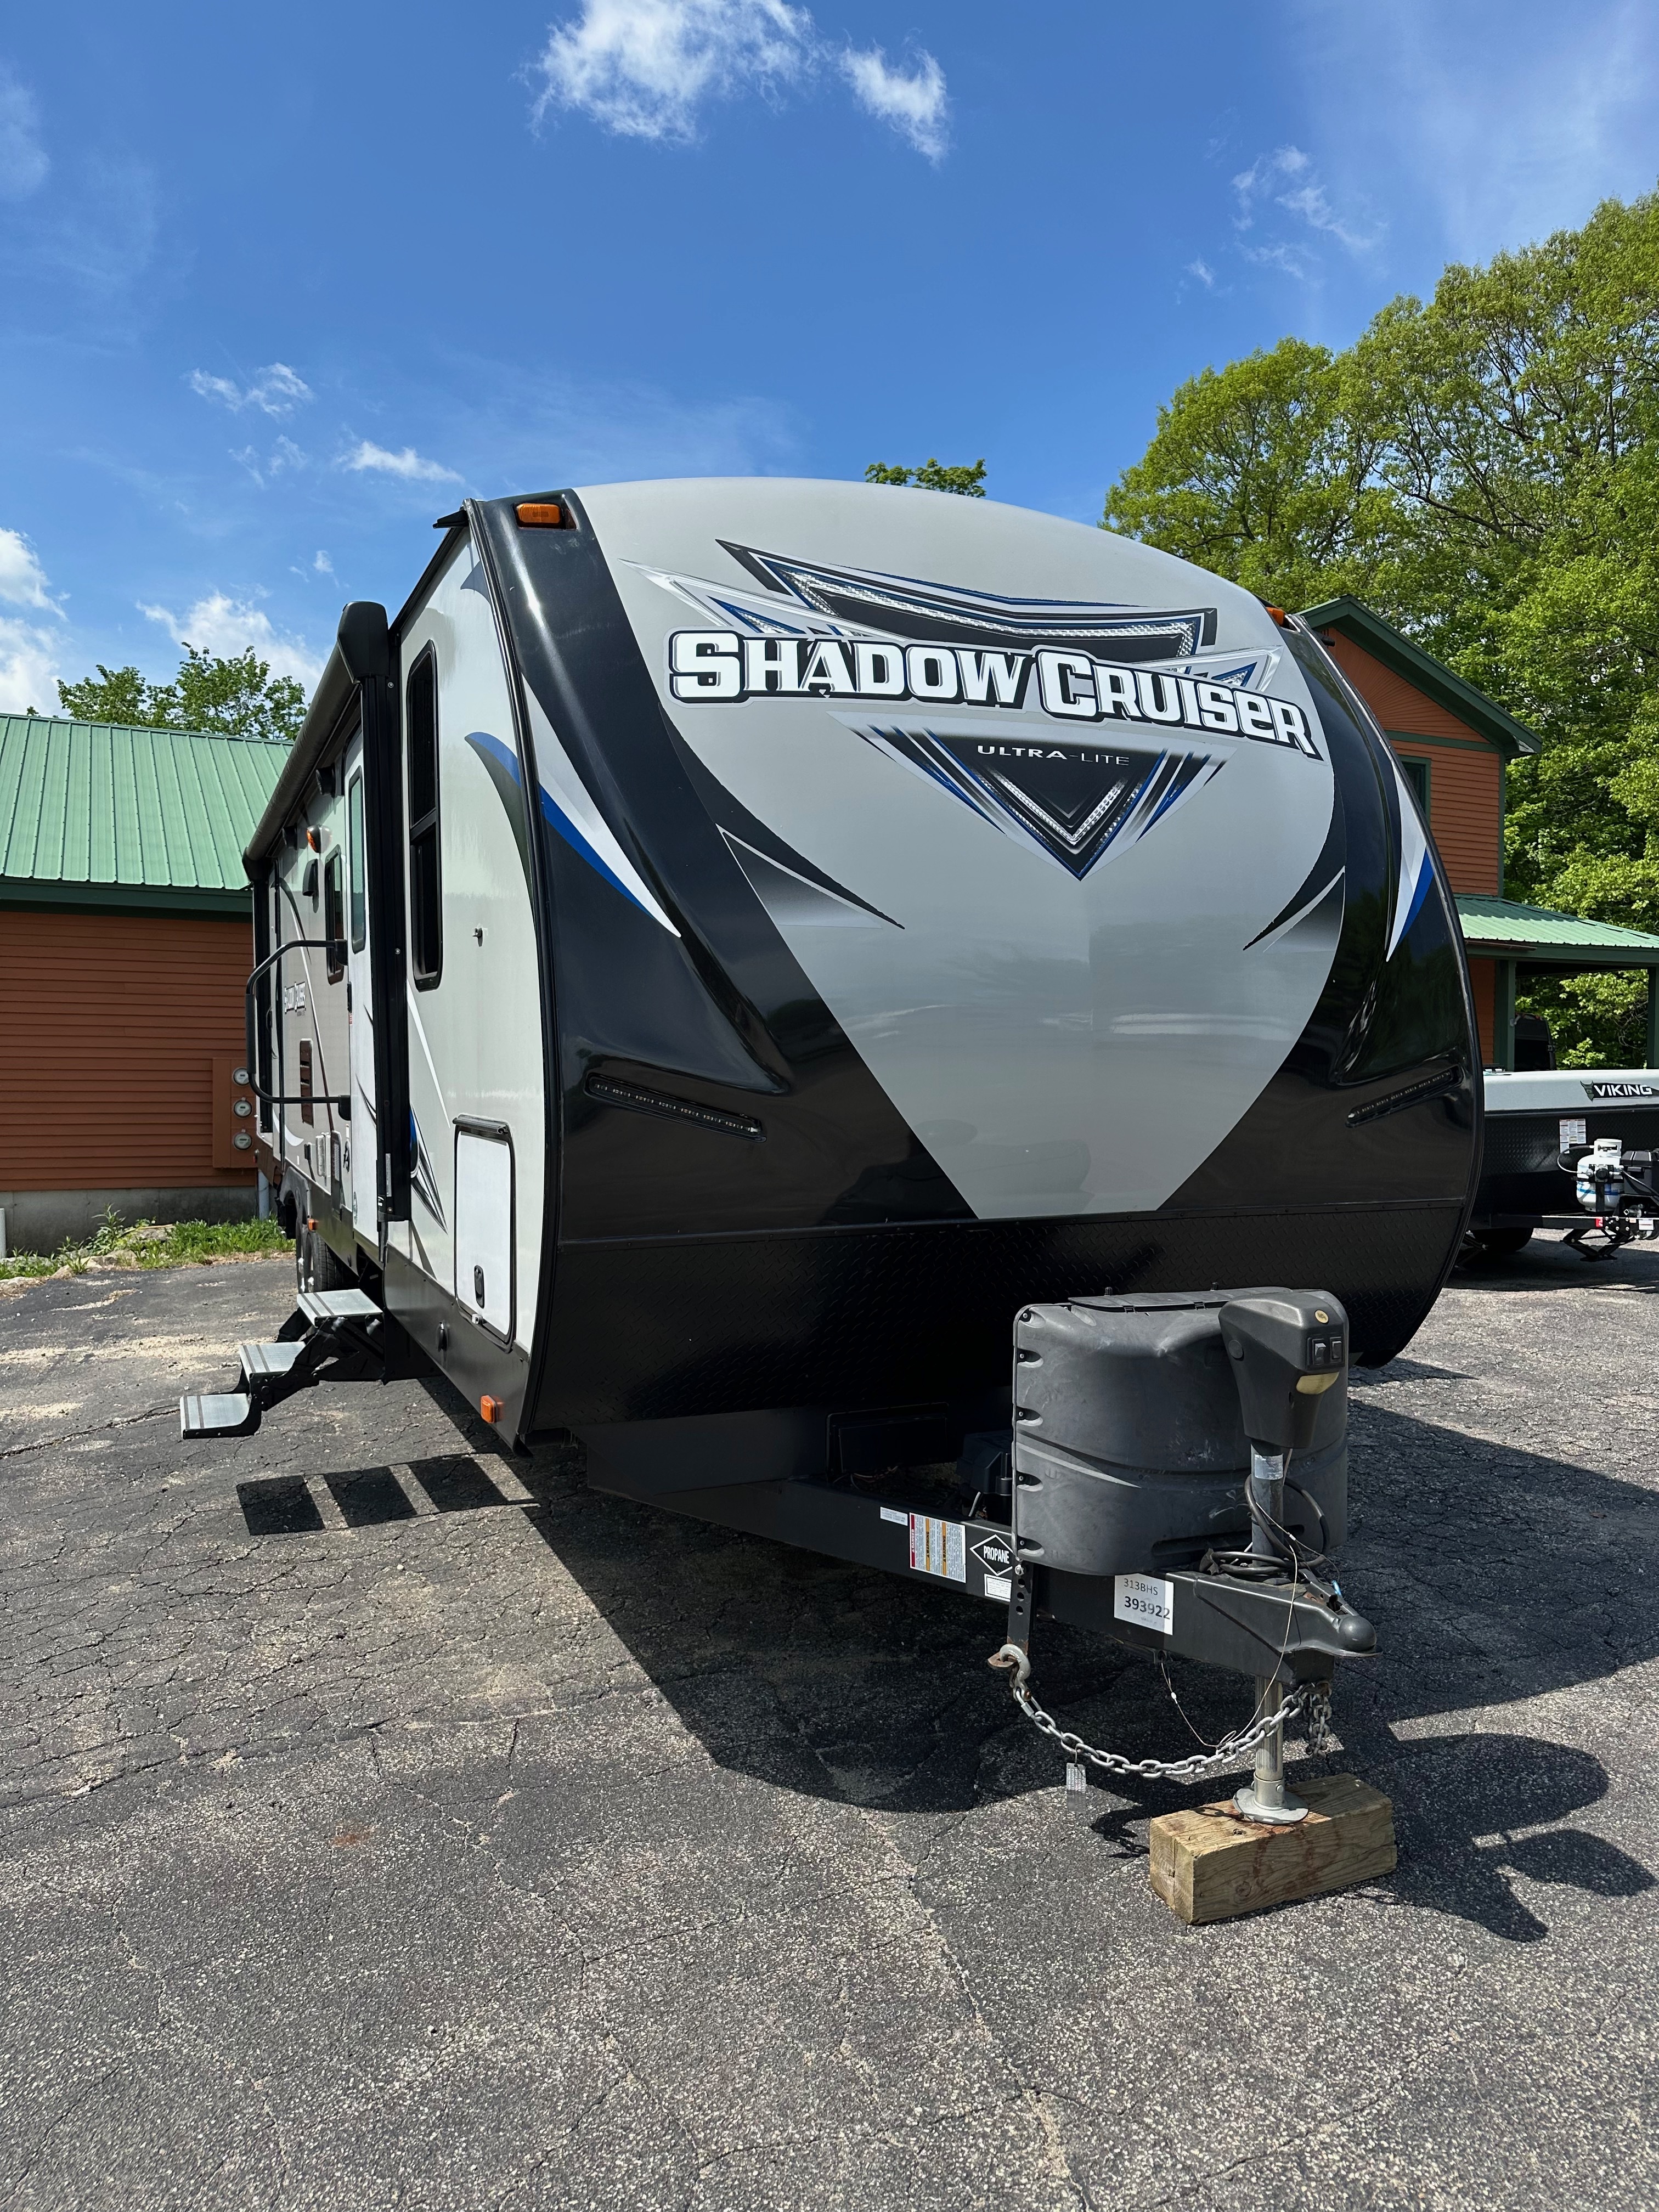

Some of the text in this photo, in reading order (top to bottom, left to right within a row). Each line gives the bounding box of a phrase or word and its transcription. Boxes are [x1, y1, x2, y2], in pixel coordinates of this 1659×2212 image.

[670, 631, 1031, 708] SHADOW
[977, 745, 1130, 766] ULTRA-LITE
[1593, 1085, 1653, 1096] VIKING
[983, 1545, 1010, 1564] PROPANE
[1124, 1578, 1158, 1595] 313BHS
[1124, 1595, 1170, 1620] 393922
